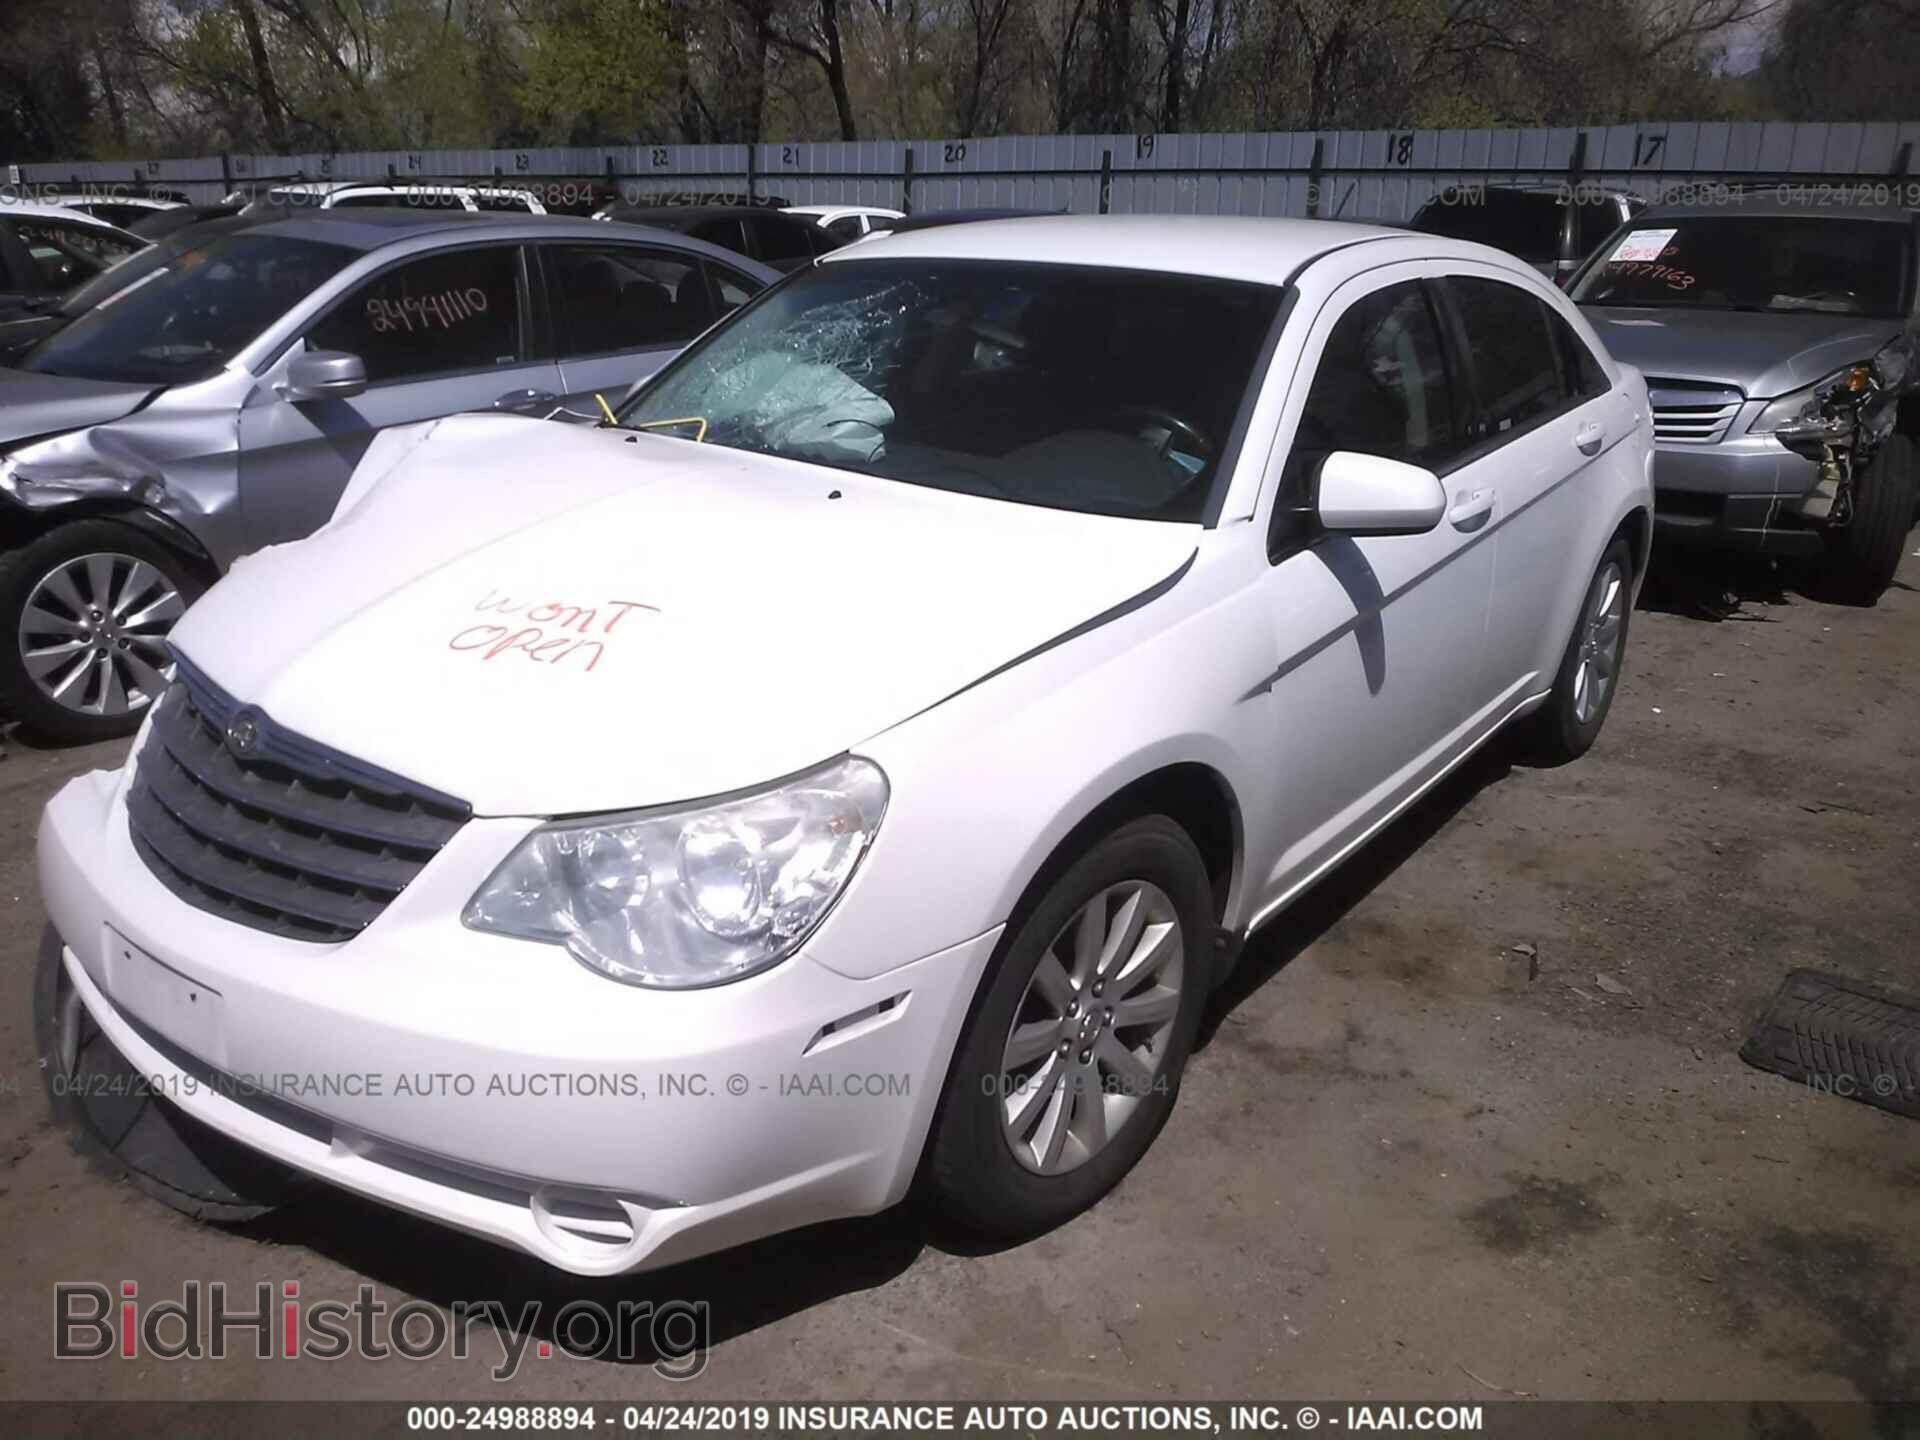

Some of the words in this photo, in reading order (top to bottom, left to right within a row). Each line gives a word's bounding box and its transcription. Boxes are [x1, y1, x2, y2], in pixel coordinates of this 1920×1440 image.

[652, 149, 669, 167] 22
[782, 146, 800, 168] 21
[944, 143, 966, 163] 20
[1136, 134, 1154, 159] 19
[1387, 133, 1414, 165] 18
[1634, 132, 1666, 167] 17
